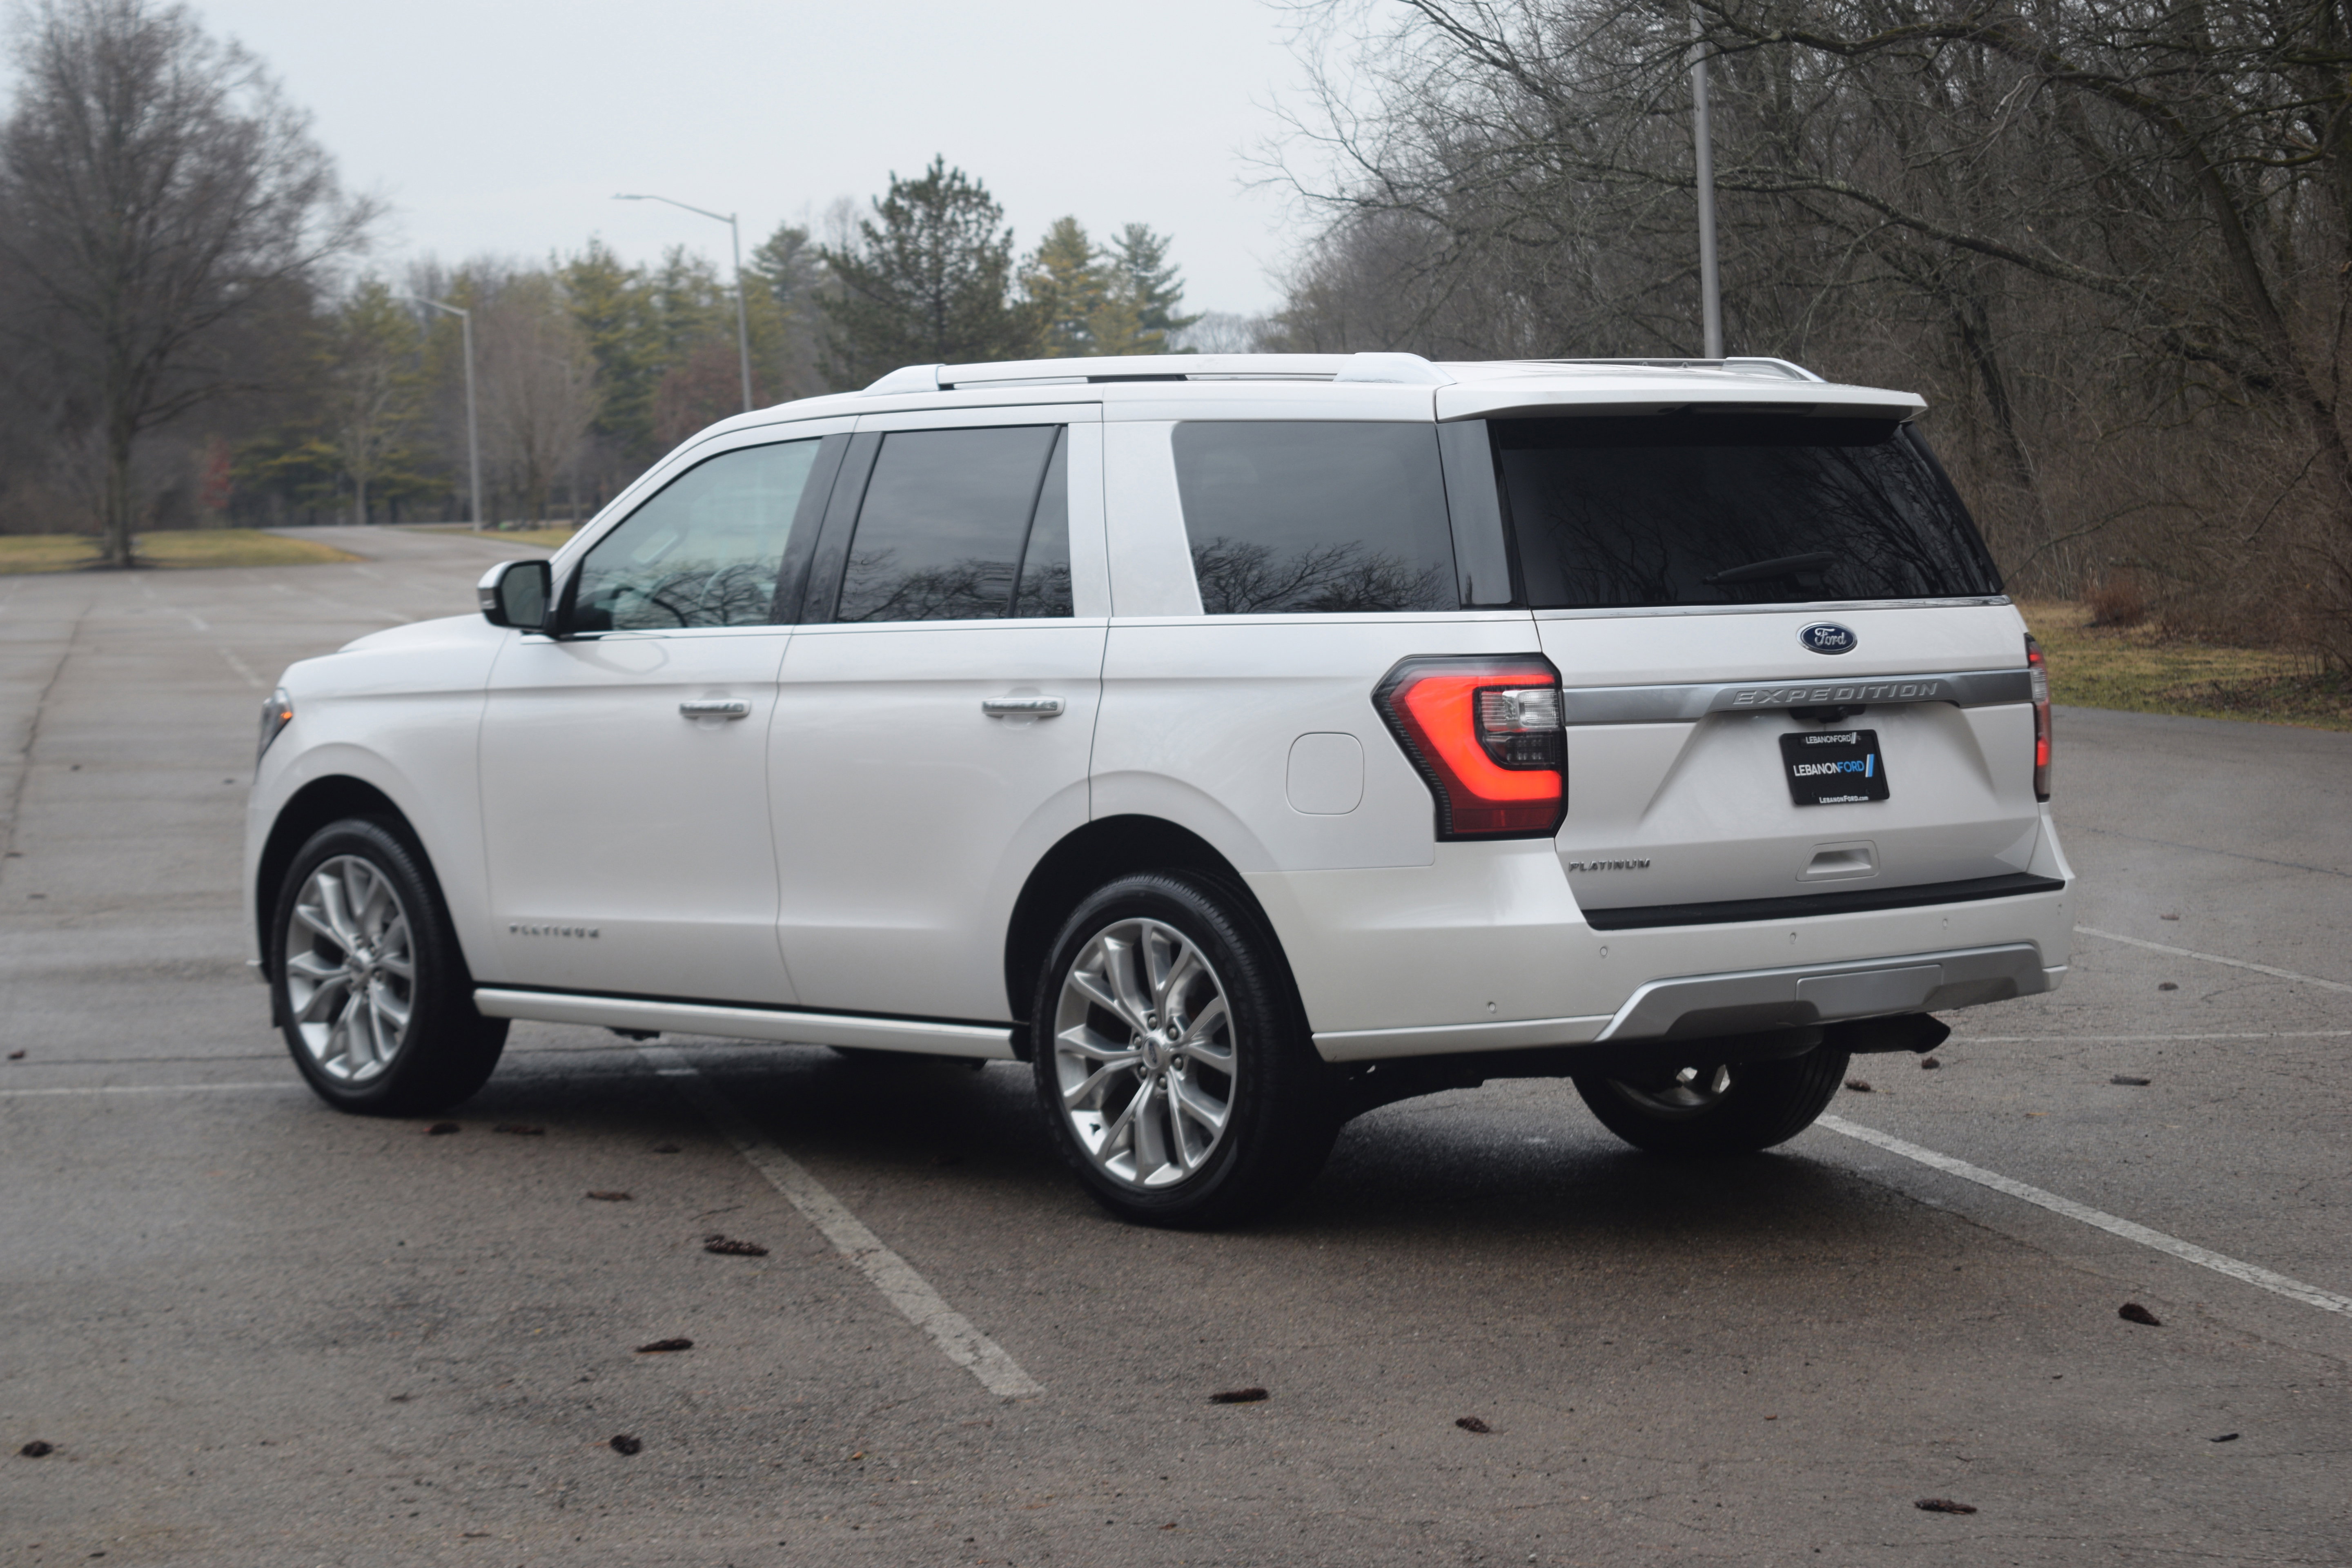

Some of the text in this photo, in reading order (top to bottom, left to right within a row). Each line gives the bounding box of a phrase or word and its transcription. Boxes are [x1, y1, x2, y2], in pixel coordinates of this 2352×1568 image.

[1815, 628, 1847, 645] Ford
[1734, 682, 1937, 704] EXPEDITION
[1569, 858, 1650, 872] PLATINUM
